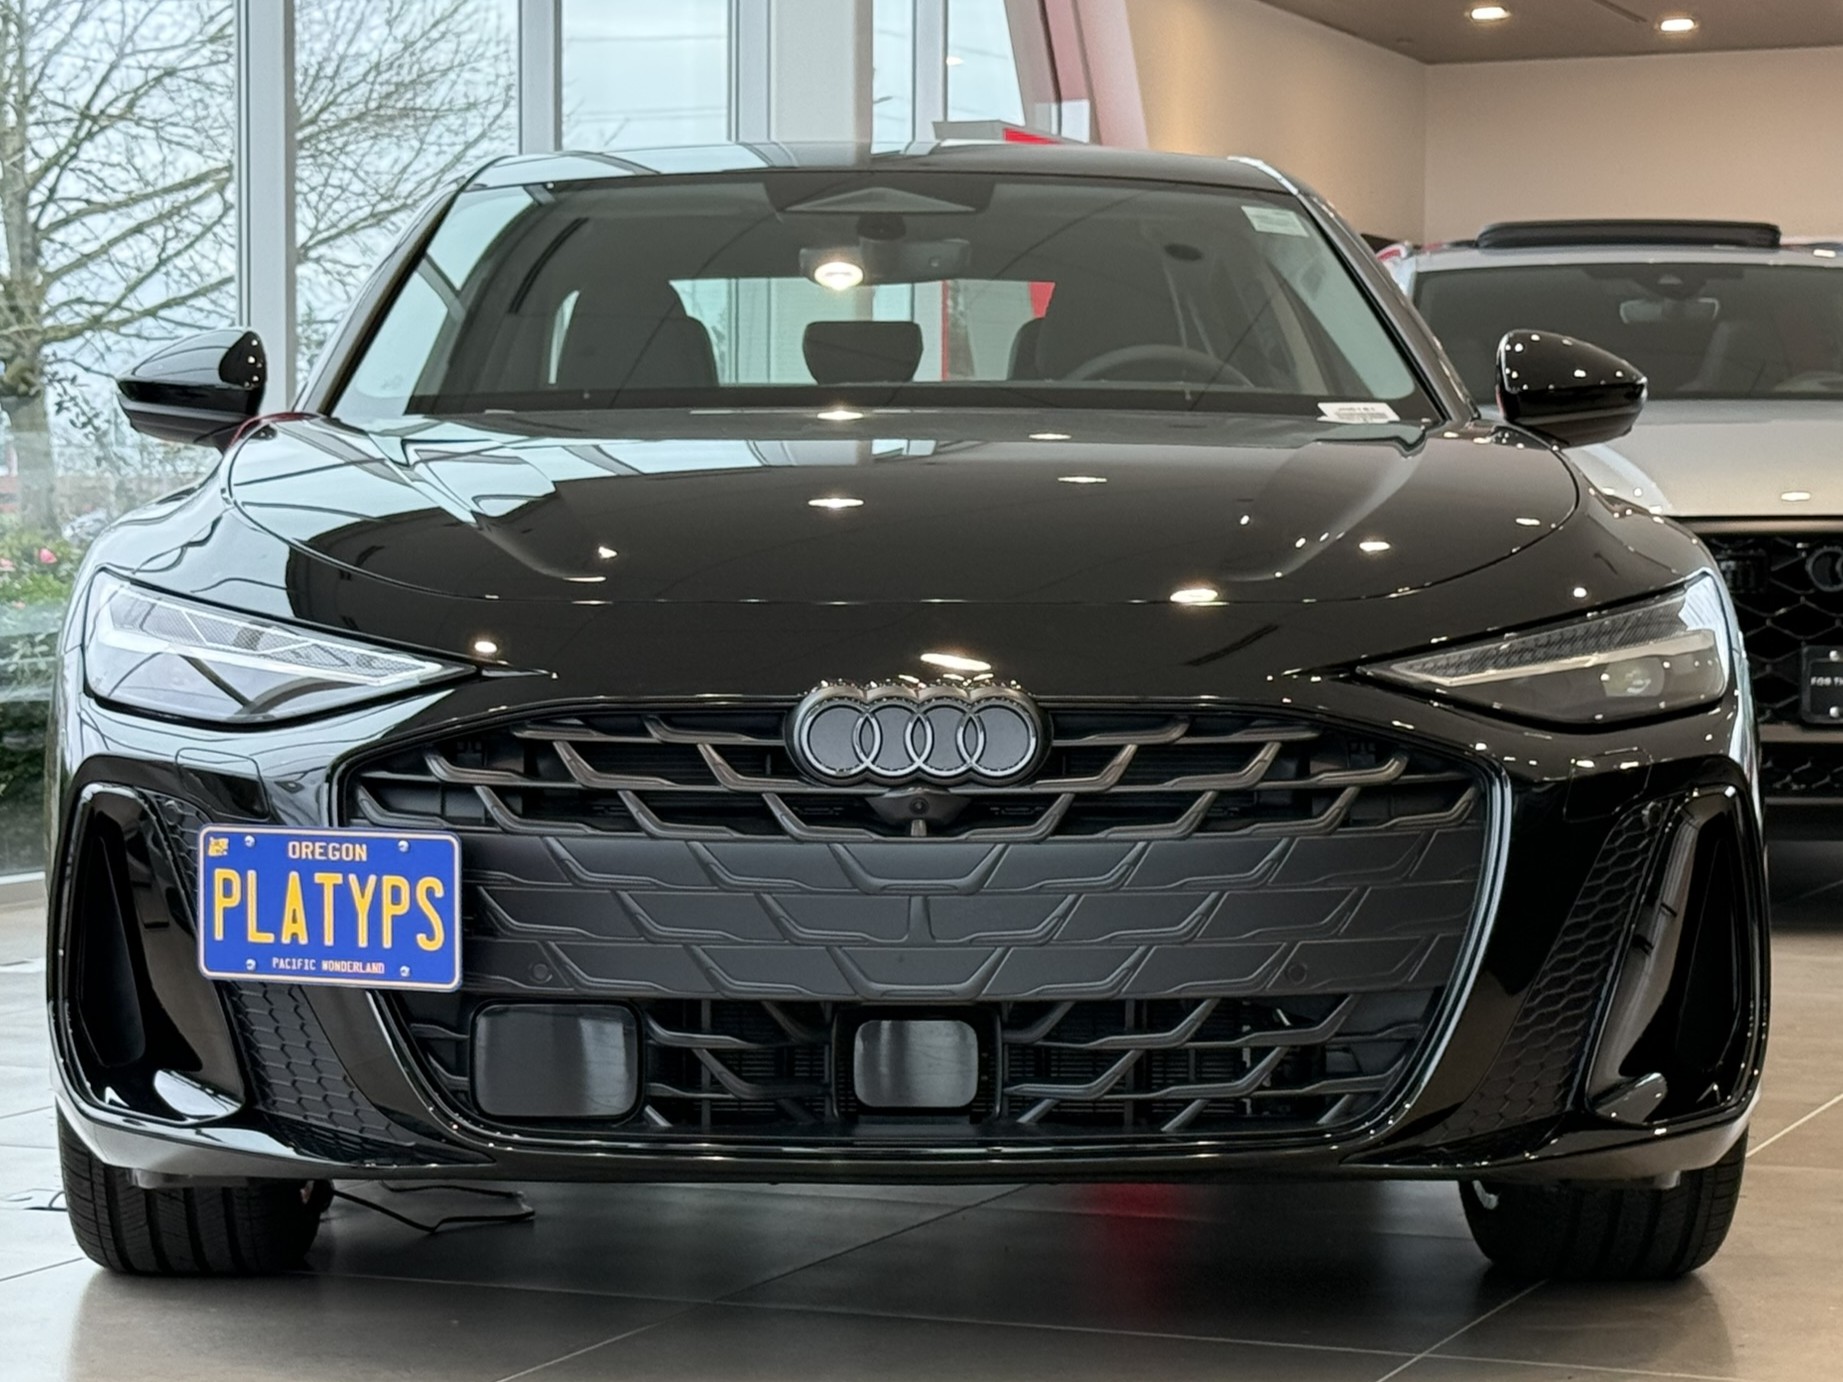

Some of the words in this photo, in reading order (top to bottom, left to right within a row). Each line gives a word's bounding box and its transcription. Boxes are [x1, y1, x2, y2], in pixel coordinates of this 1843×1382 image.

[287, 840, 368, 862] OREGON
[213, 868, 445, 951] PLATYPS
[272, 957, 316, 971] PACIFIC
[322, 960, 385, 974] WONDERLAND
